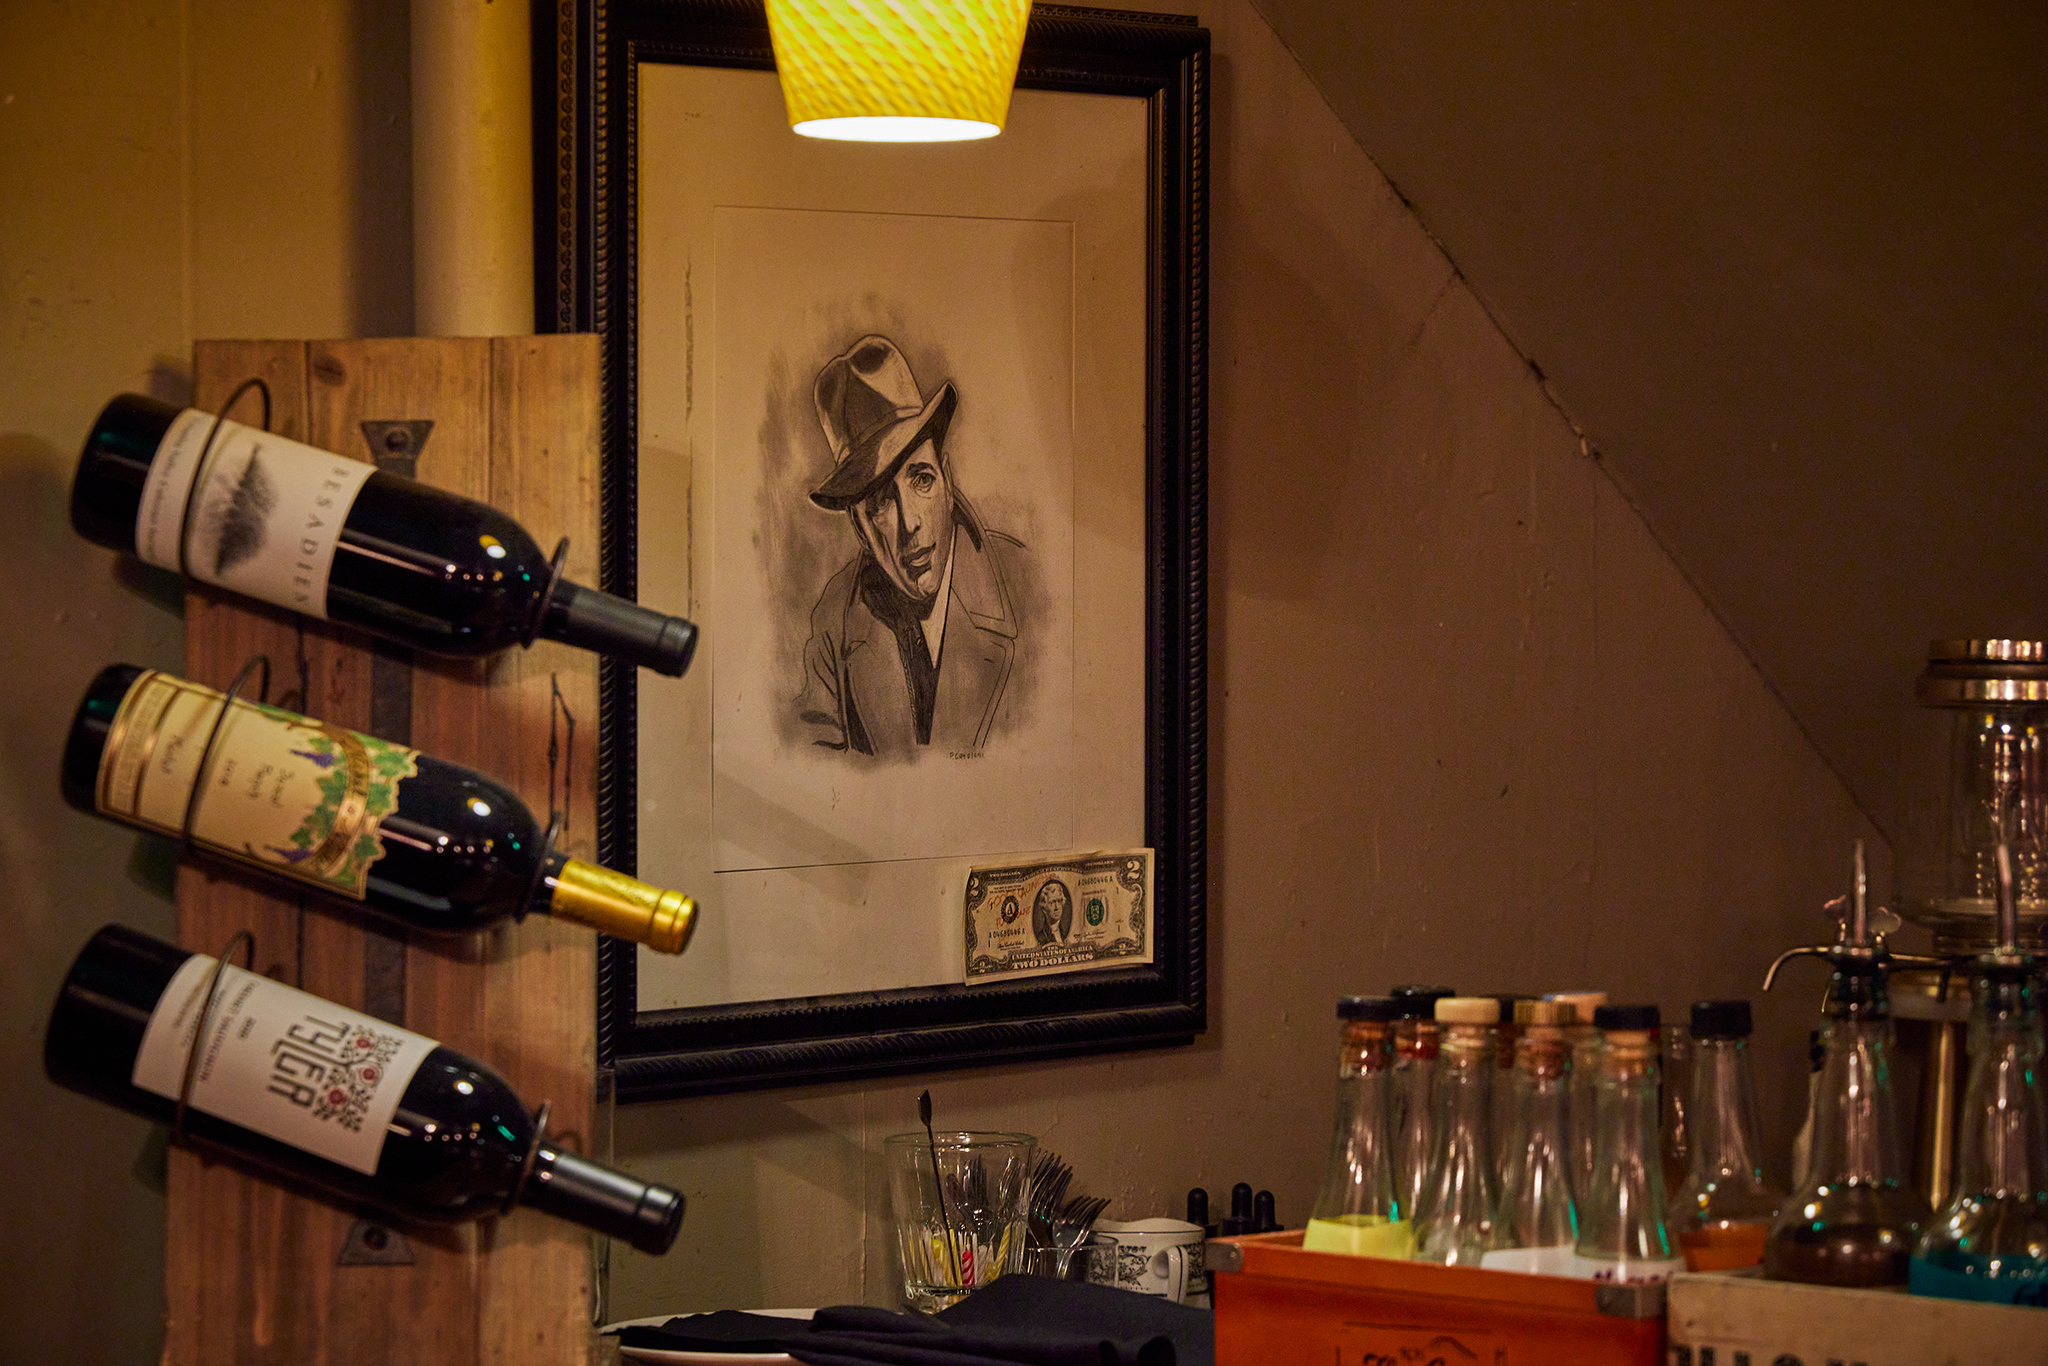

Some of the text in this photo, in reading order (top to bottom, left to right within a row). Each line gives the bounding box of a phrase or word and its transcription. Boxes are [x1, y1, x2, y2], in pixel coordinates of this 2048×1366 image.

[1126, 860, 1141, 880] 2
[970, 877, 980, 898] 2
[1011, 953, 1035, 961] UNITED
[1011, 953, 1094, 970] TWO DOLLARS
[266, 1015, 350, 1109] TYLER
